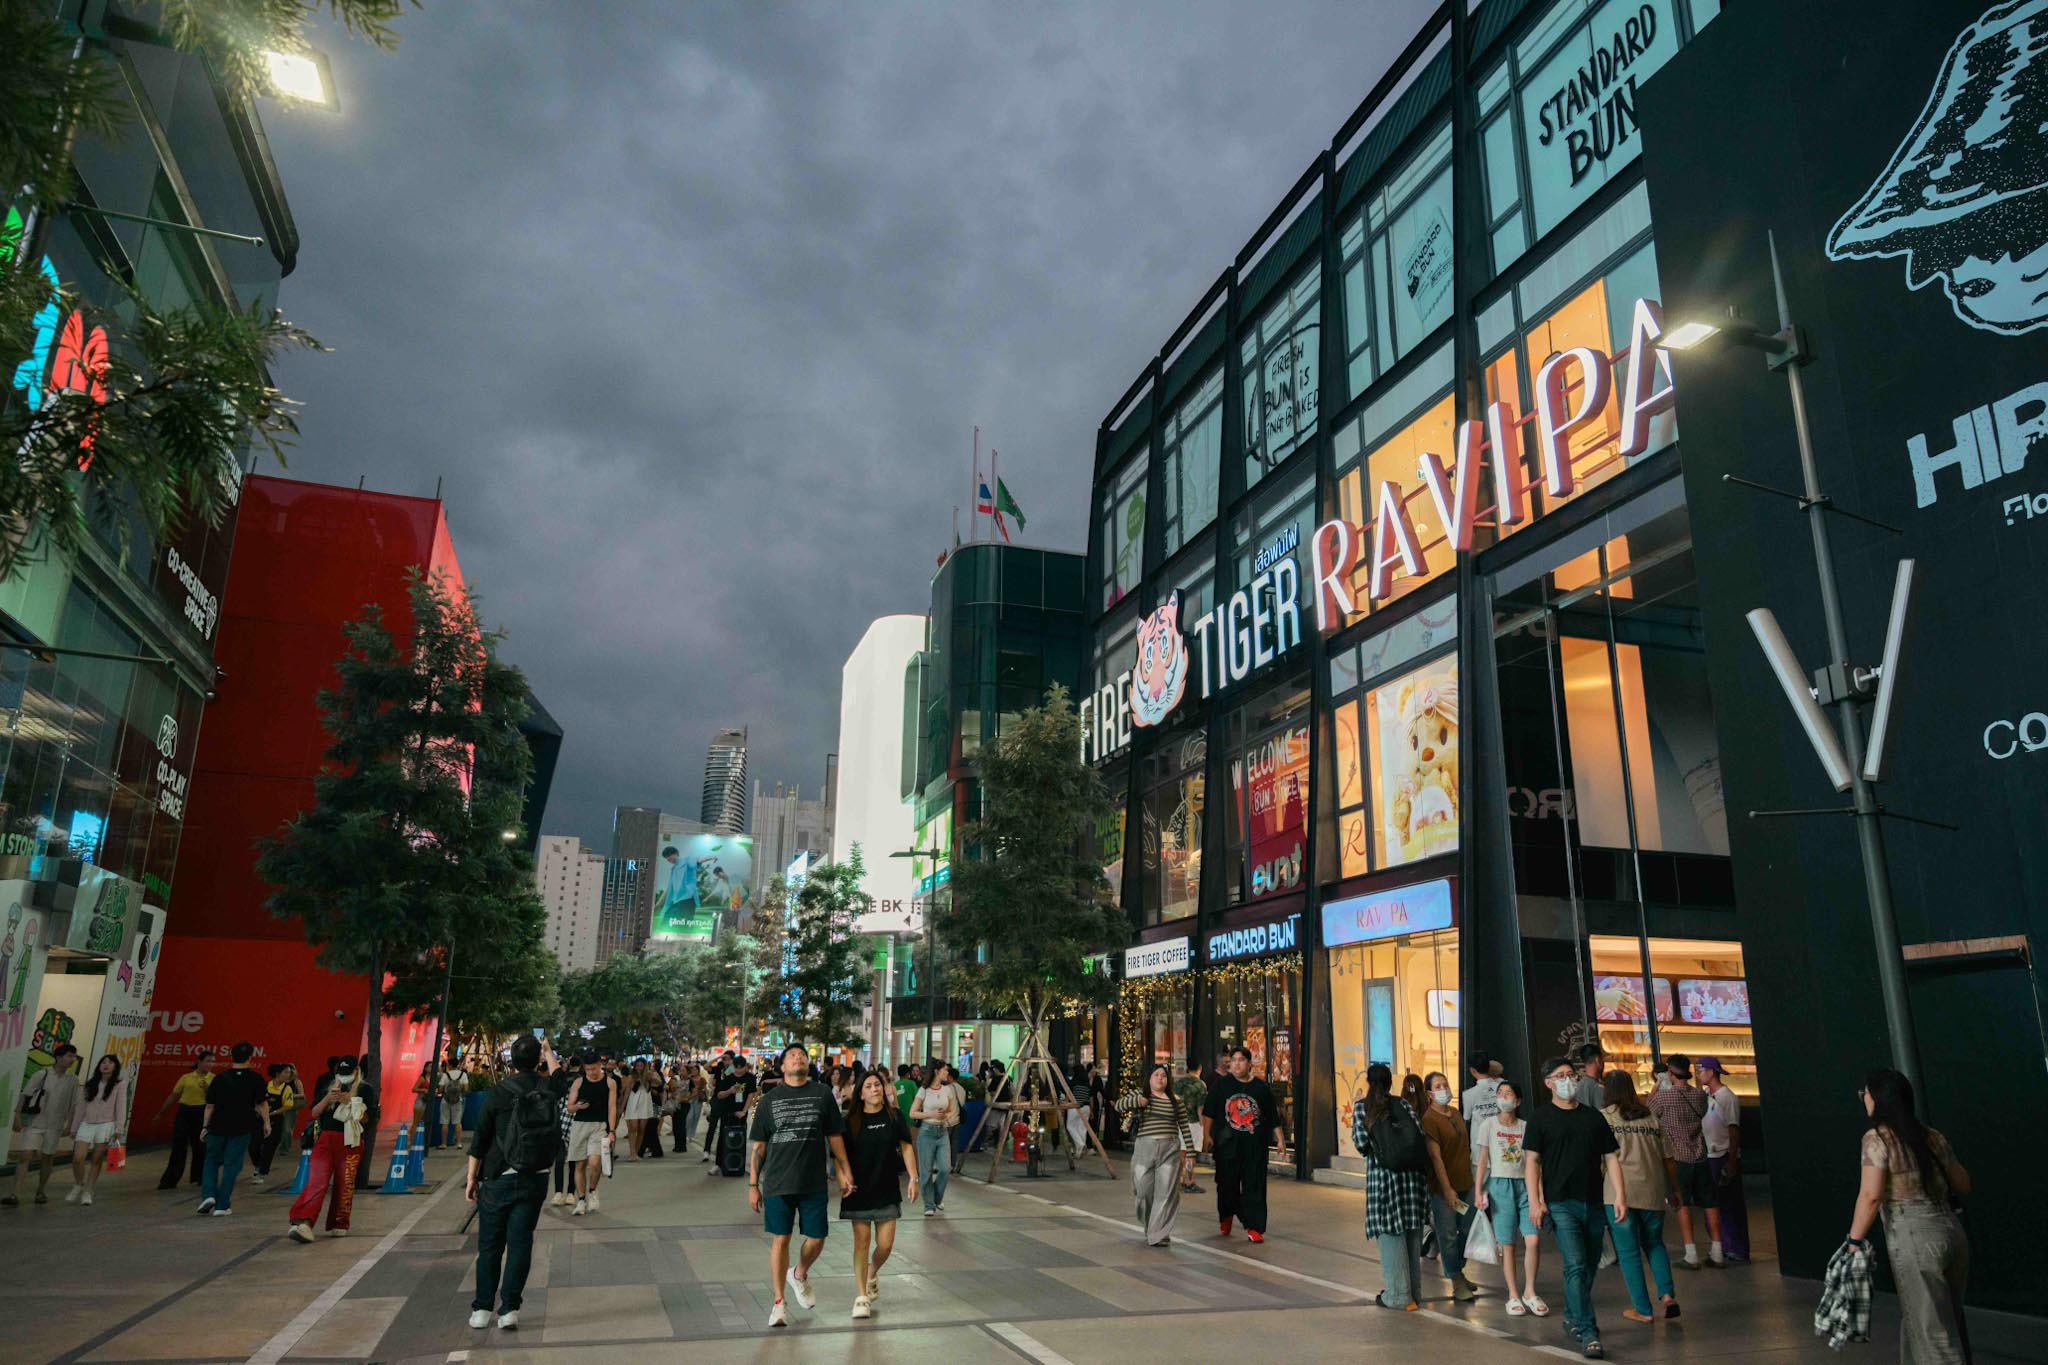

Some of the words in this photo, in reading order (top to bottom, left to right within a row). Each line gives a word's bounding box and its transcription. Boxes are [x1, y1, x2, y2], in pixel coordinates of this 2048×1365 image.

[1538, 4, 1657, 147] STANDARD
[1565, 73, 1640, 188] BUN
[1407, 223, 1442, 280] STANDARD
[1311, 297, 1675, 633] RAVIPA
[167, 546, 210, 611] CO-CREATIVE
[184, 595, 206, 633] SPACE
[1194, 556, 1301, 700] TIGER
[1079, 670, 1132, 767] FIRE
[156, 760, 187, 797] CO-PLAY
[1232, 728, 1294, 791] WELCOME
[159, 791, 183, 821] SPACE
[1254, 787, 1271, 812] BUN
[1273, 771, 1301, 804] STREET
[628, 859, 638, 871] R
[1127, 956, 1140, 970] FIRE
[1142, 952, 1161, 967] TIGER
[1162, 949, 1187, 964] COFFEE
[1209, 926, 1267, 961] STANDARD
[1269, 918, 1295, 950] BUN
[147, 1009, 205, 1034] rue
[153, 1043, 182, 1056] SEE
